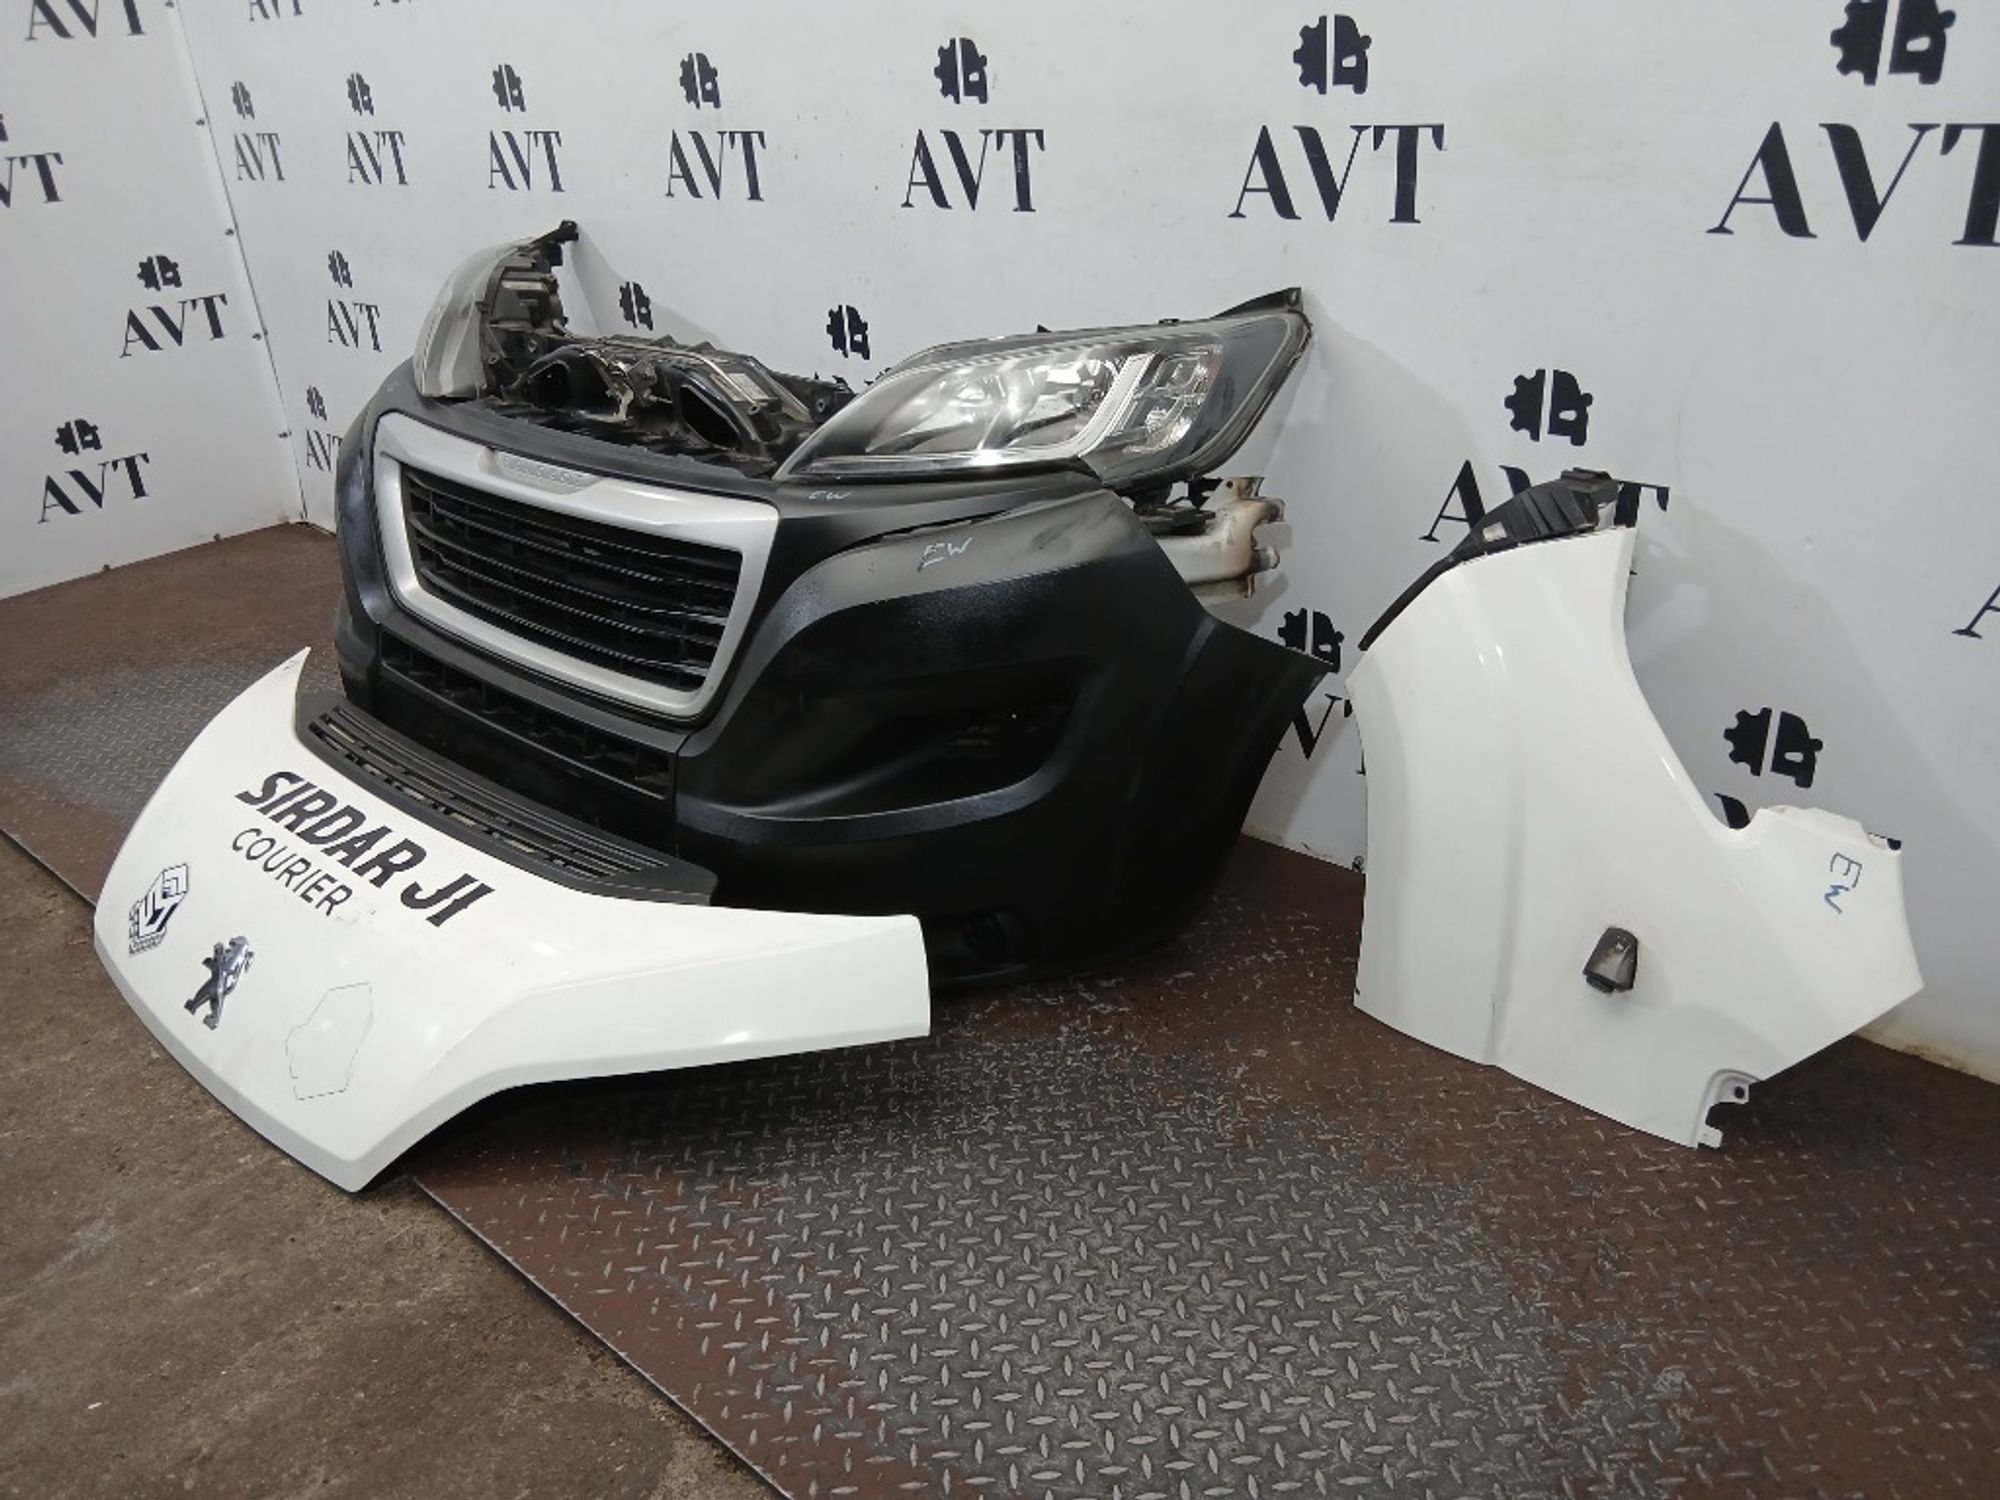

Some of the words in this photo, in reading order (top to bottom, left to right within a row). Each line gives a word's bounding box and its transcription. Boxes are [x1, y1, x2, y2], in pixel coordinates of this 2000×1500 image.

[233, 132, 285, 181] AVT
[347, 130, 408, 185] AVT
[488, 130, 565, 192] AVT
[666, 129, 766, 201] AVT
[901, 129, 1045, 212] AVT
[1228, 123, 1447, 224] AVT
[119, 293, 228, 358] AVT
[327, 299, 382, 352] AVT
[37, 452, 150, 524] AVT
[232, 828, 353, 916] COURIER
[234, 771, 427, 888] SIRDAR
[400, 873, 495, 927] JI
